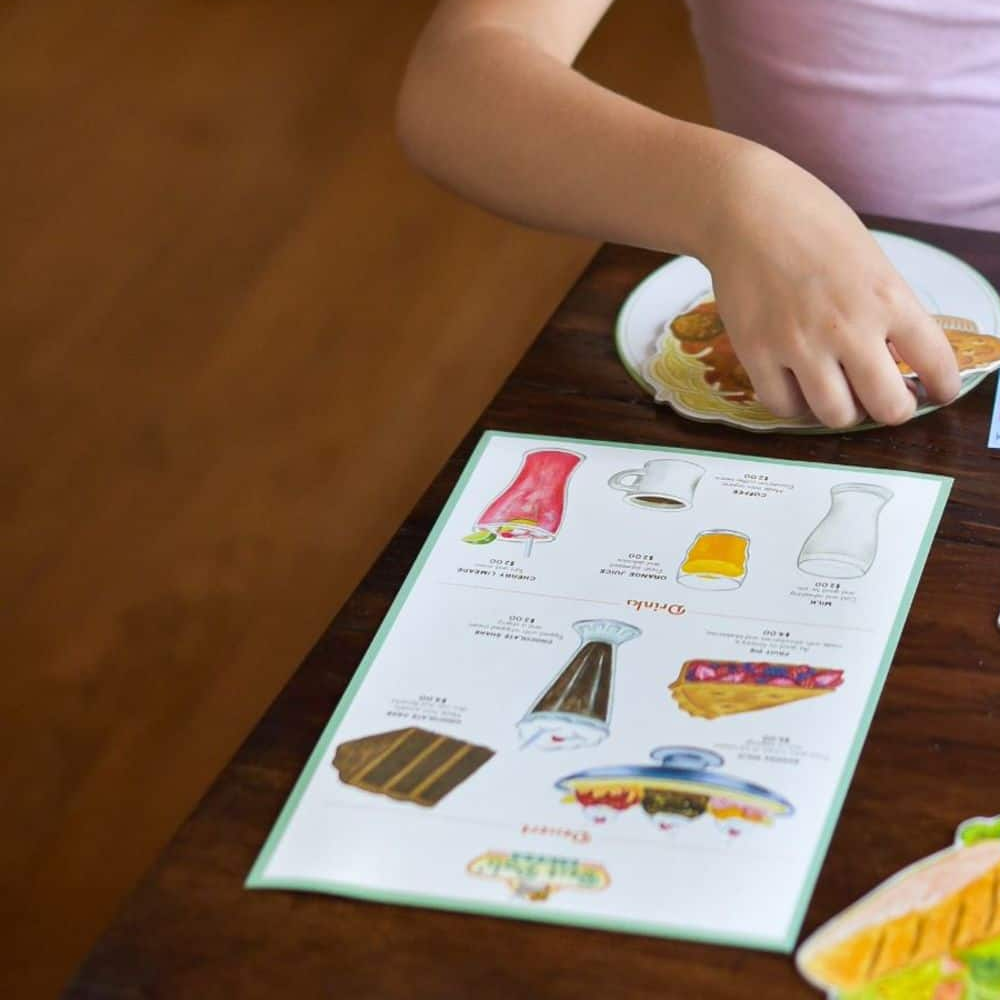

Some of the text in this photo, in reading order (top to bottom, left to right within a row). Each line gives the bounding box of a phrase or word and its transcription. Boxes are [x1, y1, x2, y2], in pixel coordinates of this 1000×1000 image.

[456, 567, 497, 577] LIMEADE
[599, 568, 668, 581] ORANGE JUICE
[499, 573, 537, 582] CHERRY
[626, 599, 686, 617] Drinks
[809, 599, 833, 608] MILK
